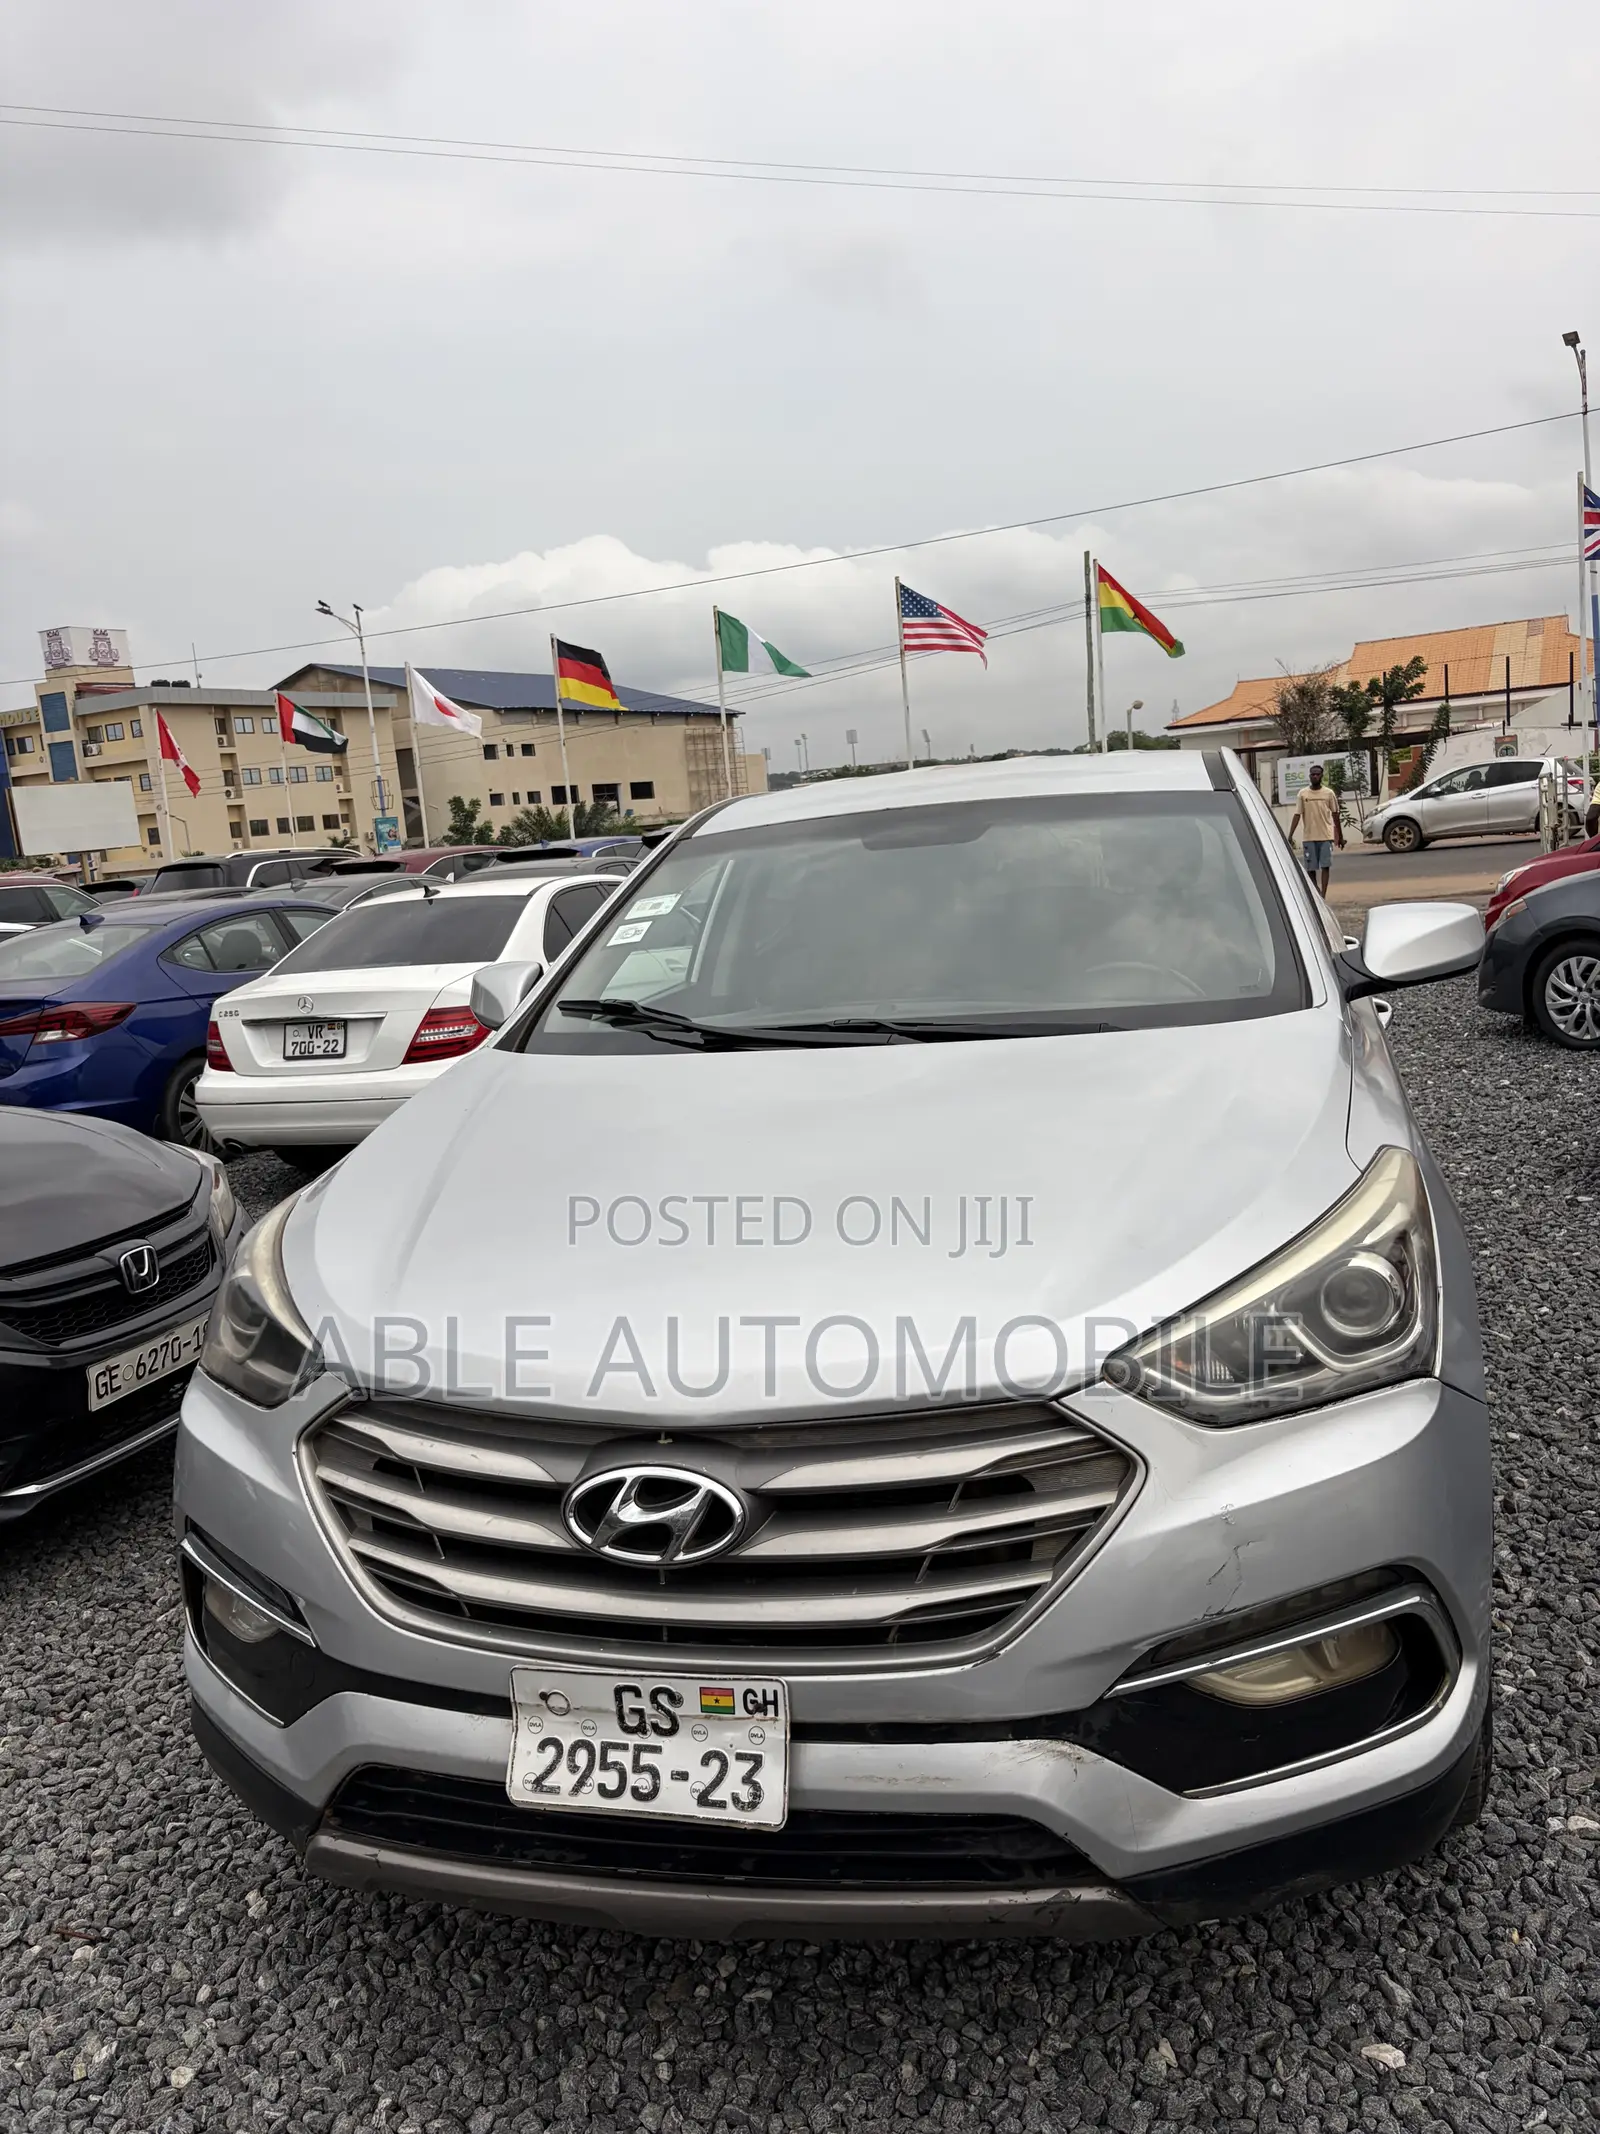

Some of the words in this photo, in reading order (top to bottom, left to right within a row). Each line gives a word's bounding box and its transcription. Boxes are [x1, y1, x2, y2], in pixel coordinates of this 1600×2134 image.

[291, 1039, 340, 1056] 700-22
[307, 1024, 323, 1039] VR
[95, 1363, 122, 1399] GE
[613, 1683, 681, 1737] GS
[743, 1688, 779, 1717] GH
[532, 1737, 763, 1811] 2955-23
